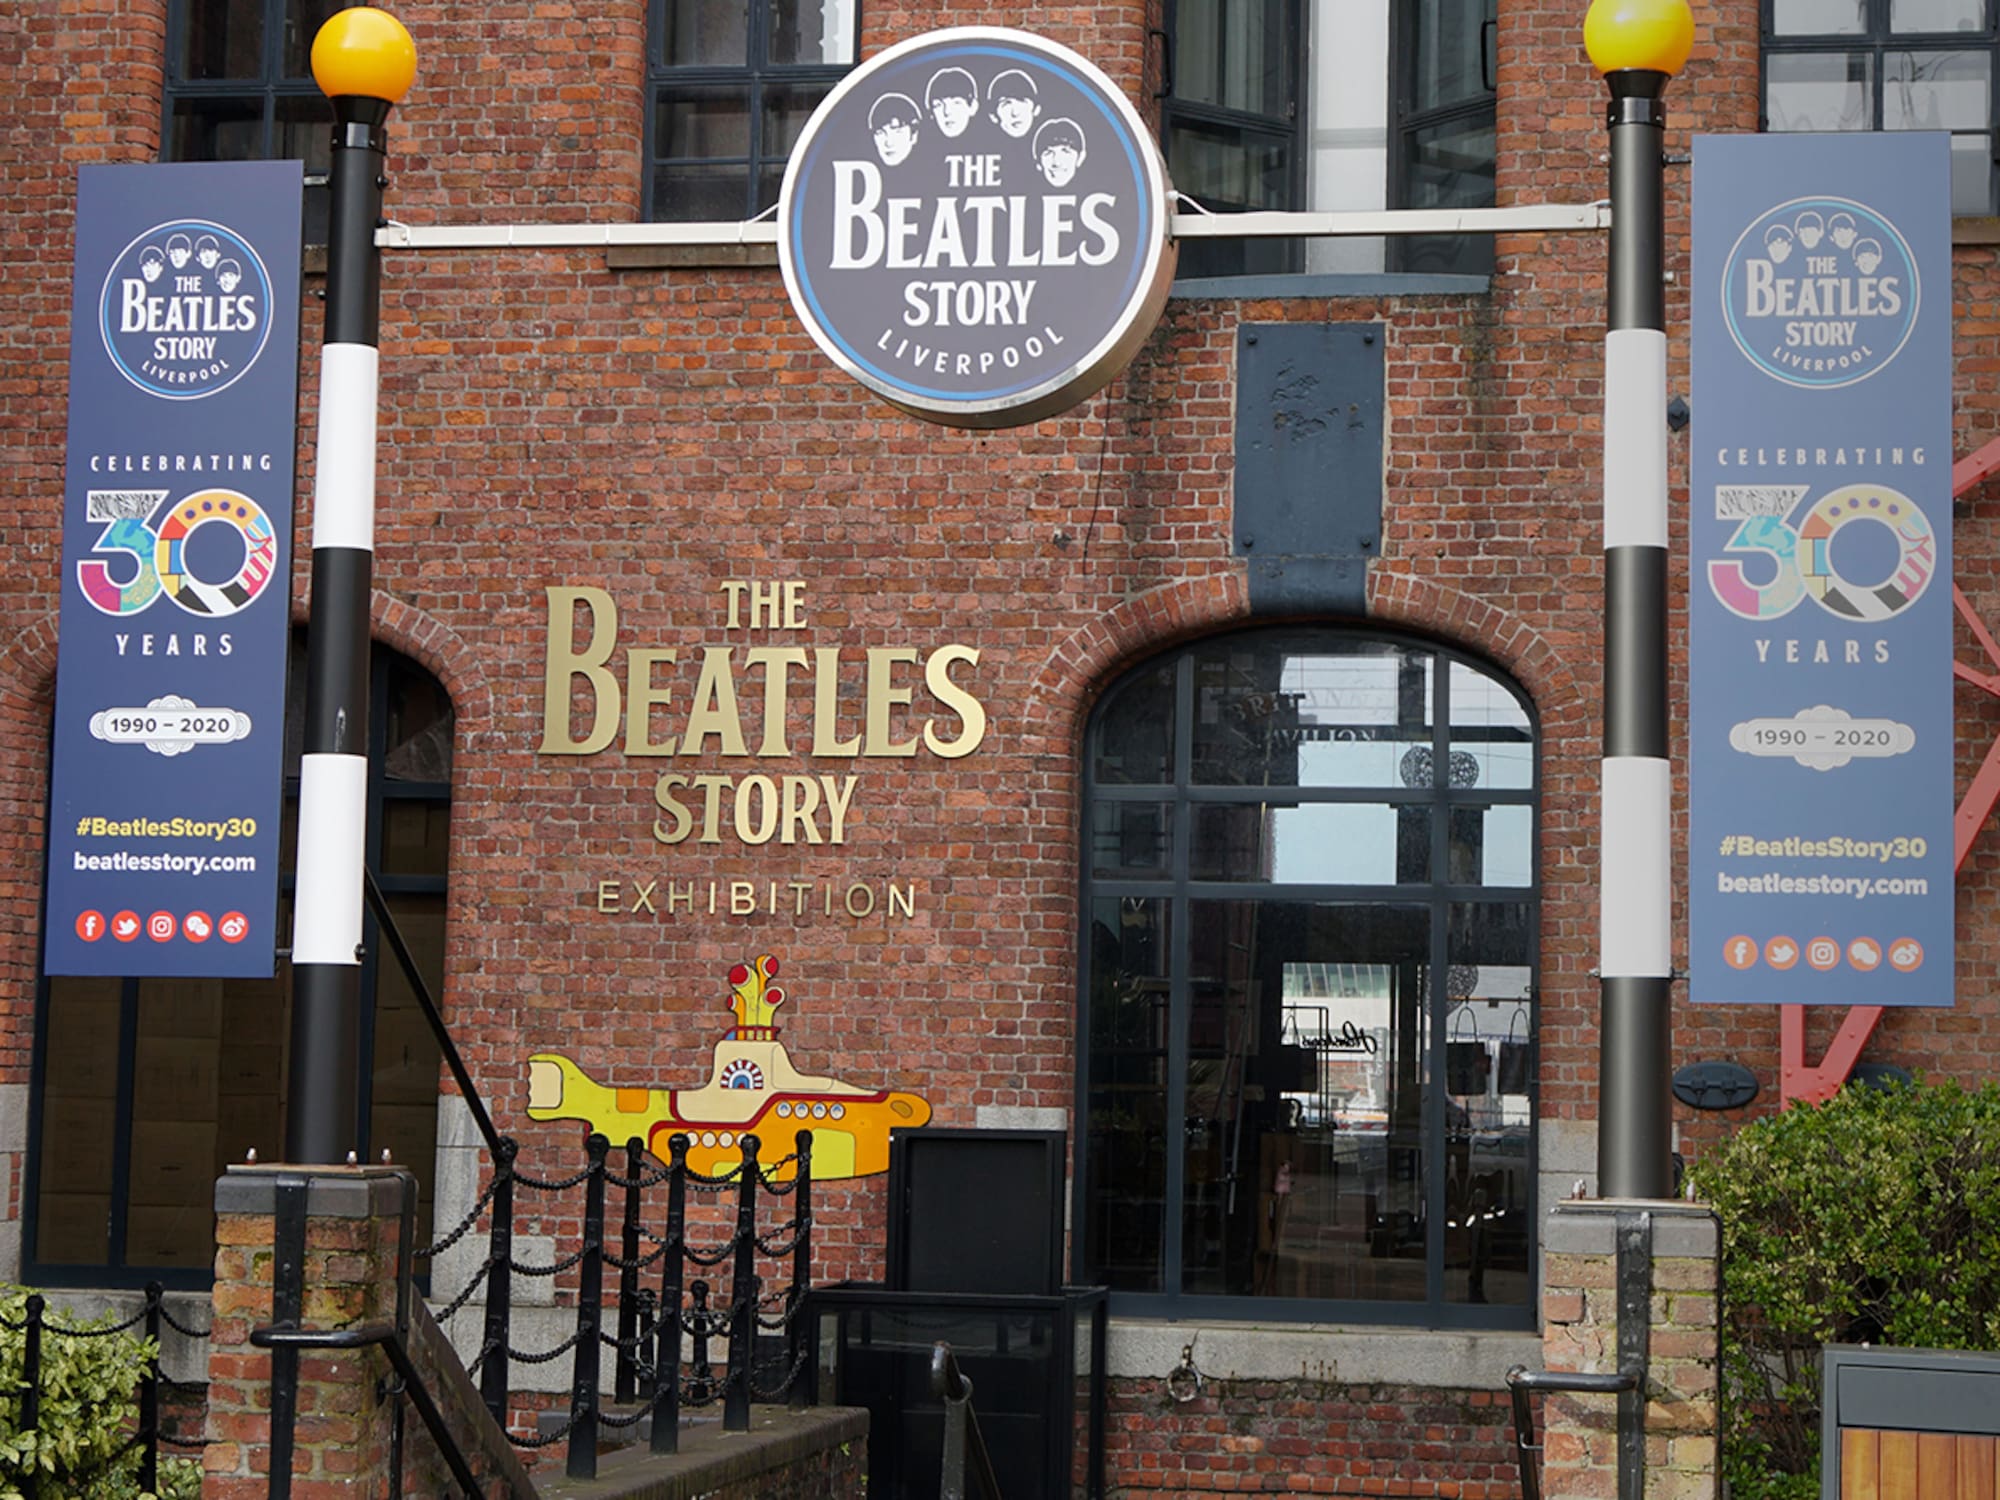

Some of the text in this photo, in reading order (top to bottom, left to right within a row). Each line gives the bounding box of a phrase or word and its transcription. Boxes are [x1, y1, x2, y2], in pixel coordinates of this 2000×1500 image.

[945, 154, 1001, 187] THE
[829, 160, 1120, 269] BEATLES
[1805, 256, 1838, 275] THE
[174, 275, 202, 293] THE
[1745, 259, 1902, 317] BEATLES
[120, 278, 256, 333] BEATLES
[903, 280, 1037, 326] STORY
[1785, 321, 1857, 347] STORY
[153, 336, 217, 361] STORY
[877, 326, 1064, 375] LIVERPOOL
[1772, 345, 1873, 371] LIVERPOOL
[141, 359, 229, 384] LIVERPOOL
[90, 454, 271, 472] CELEBRATING
[1717, 447, 1925, 467] CELEBRATING
[77, 488, 278, 618] 30
[1707, 483, 1937, 623] 30
[719, 580, 808, 630] THE
[115, 633, 233, 657] YEARS
[1754, 639, 1890, 664] YEARS
[538, 585, 988, 759] BEATLES
[110, 717, 157, 734] 1990
[180, 717, 230, 734] 2020
[1753, 729, 1807, 746] 1990
[1834, 729, 1891, 746] 2020
[653, 774, 859, 844] STORY
[76, 817, 257, 842] #BeatlesStory30
[1719, 835, 1928, 863] #BeatlesStory30
[74, 852, 256, 876] beatlesstory.com
[1718, 872, 1928, 898] beatlesstory.com
[597, 880, 917, 918] EXHIBITION
